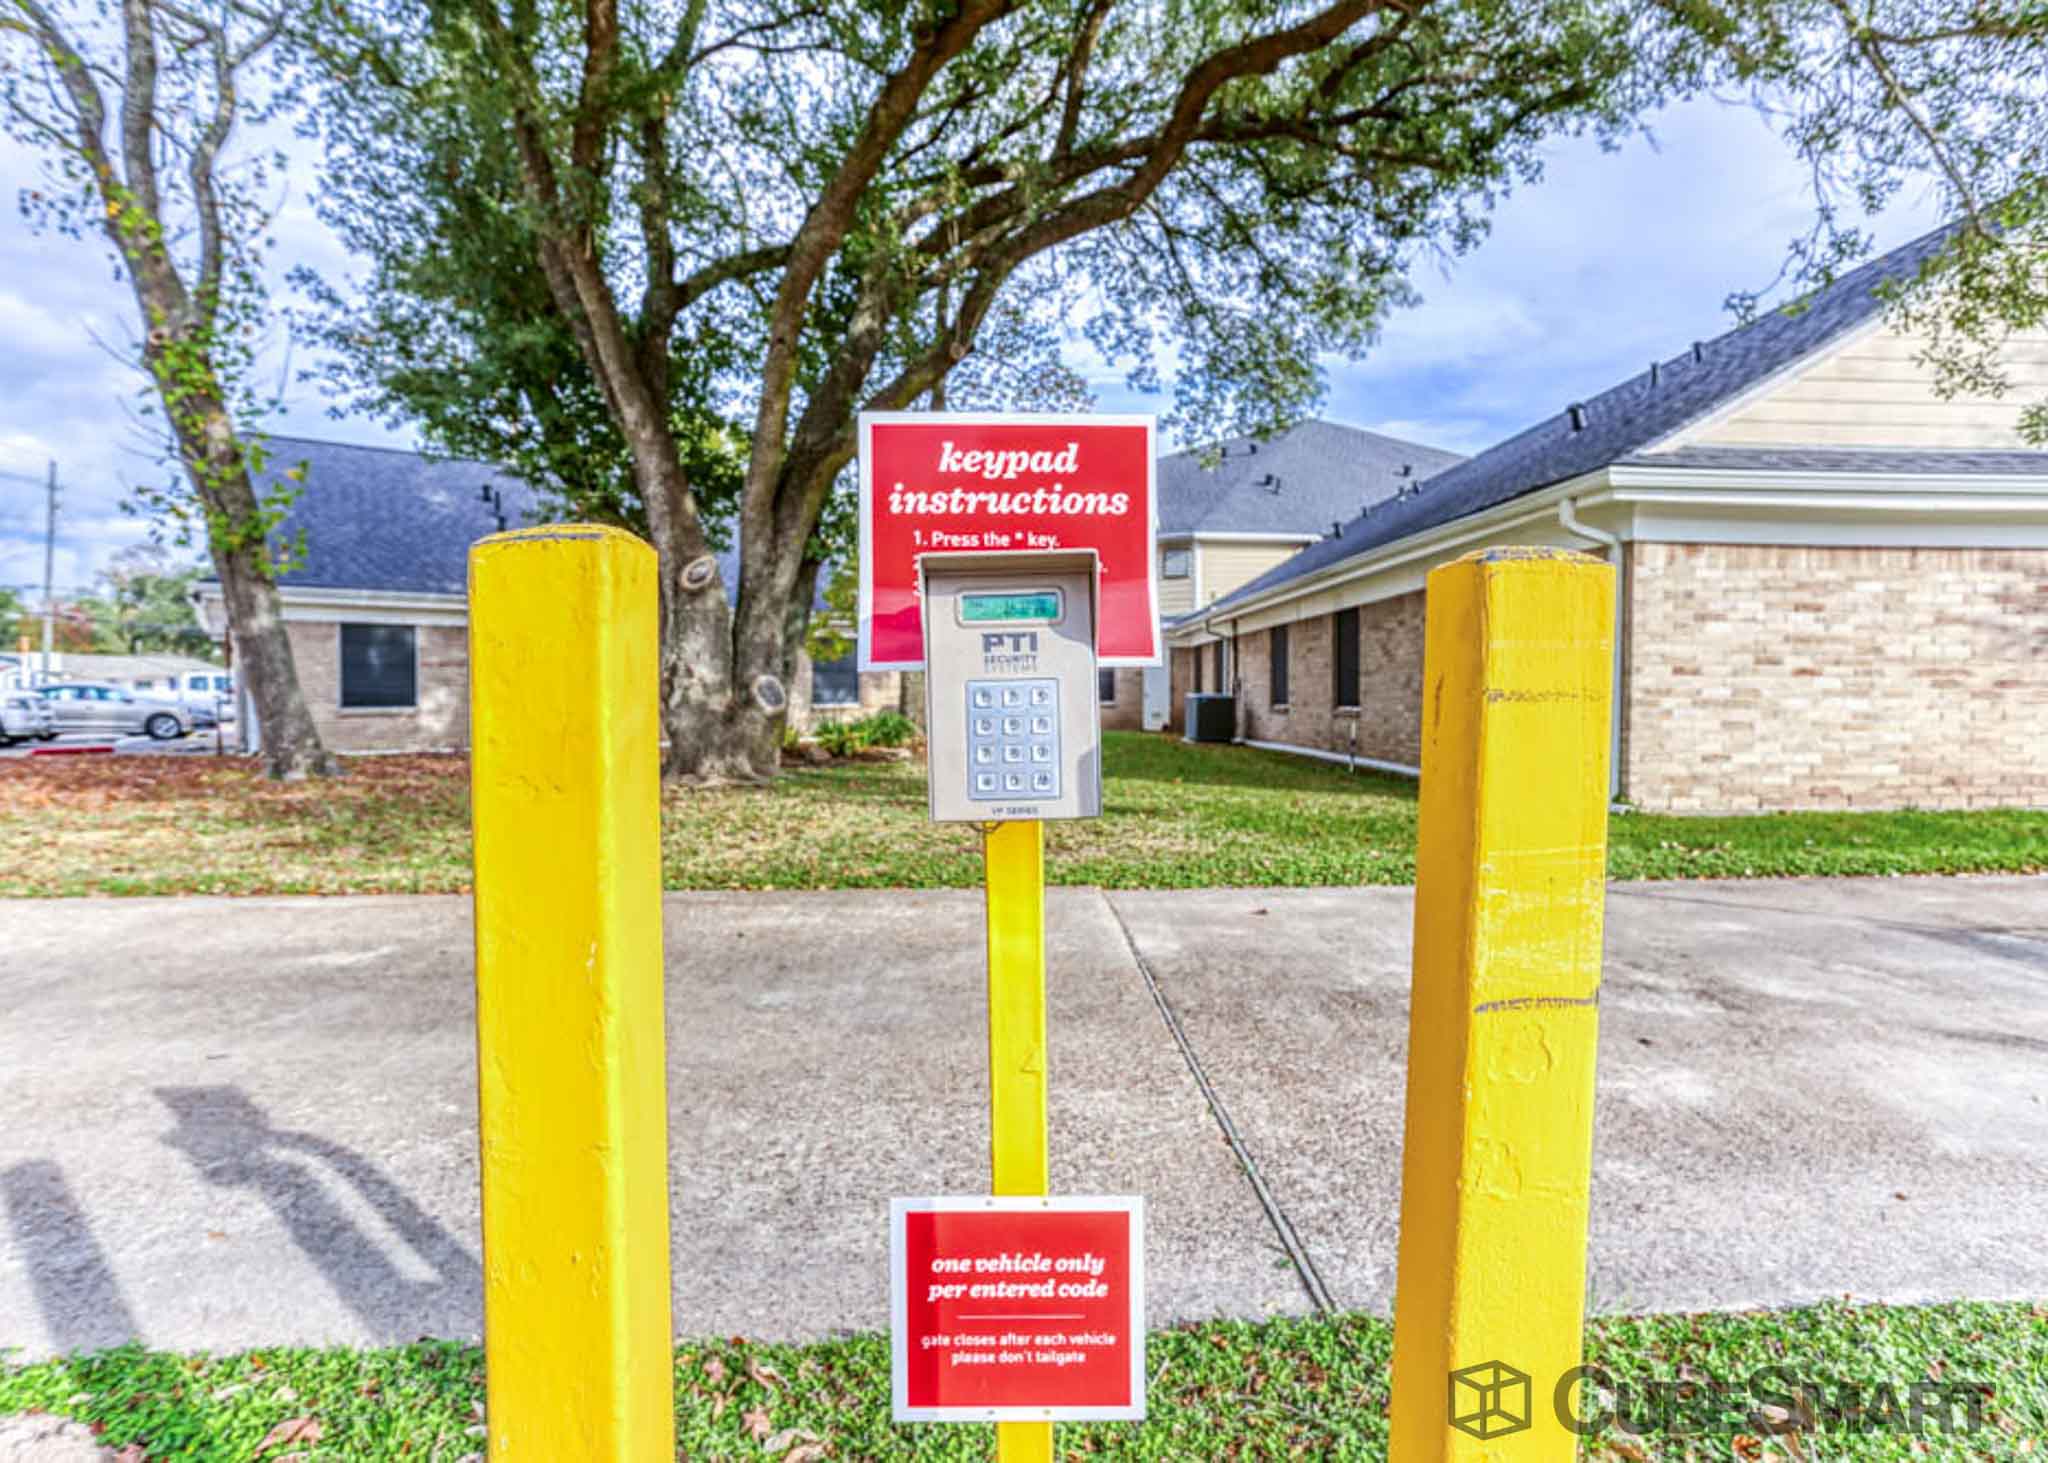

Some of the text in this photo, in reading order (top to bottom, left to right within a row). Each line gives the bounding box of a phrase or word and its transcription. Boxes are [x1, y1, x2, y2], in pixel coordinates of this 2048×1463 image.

[938, 440, 1080, 480] keypad
[888, 481, 1130, 516] instructions
[913, 530, 928, 546] 1.
[931, 530, 980, 547] Press
[983, 530, 1011, 547] the
[1027, 531, 1061, 550] key.
[982, 632, 1038, 653] PTI
[931, 1252, 1106, 1276] one vehicle only
[927, 1279, 1109, 1302] per entered code
[921, 1332, 1117, 1350] gate closes after each vehicle
[951, 1351, 1087, 1367] please don't tailgate
